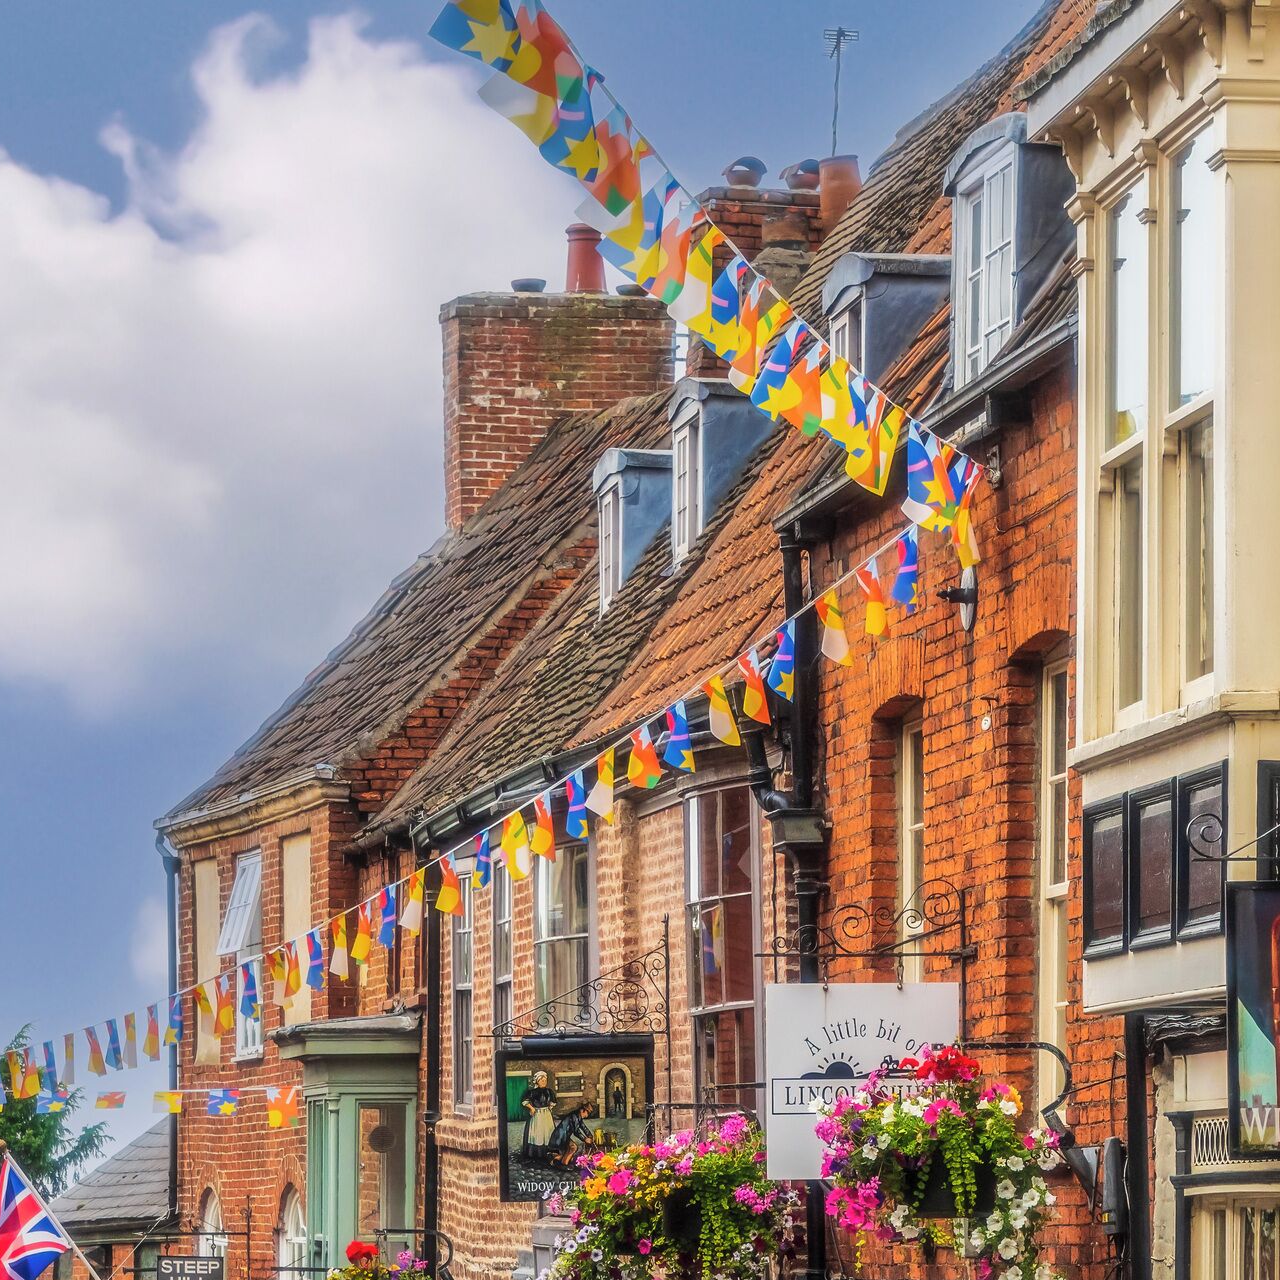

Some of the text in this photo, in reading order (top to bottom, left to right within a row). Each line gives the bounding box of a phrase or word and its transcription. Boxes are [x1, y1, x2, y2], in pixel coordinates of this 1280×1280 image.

[803, 1036, 822, 1057] A
[822, 1017, 868, 1045] little
[876, 1018, 902, 1044] bit
[517, 1181, 555, 1193] WIDOW
[161, 1260, 220, 1275] STEEP
